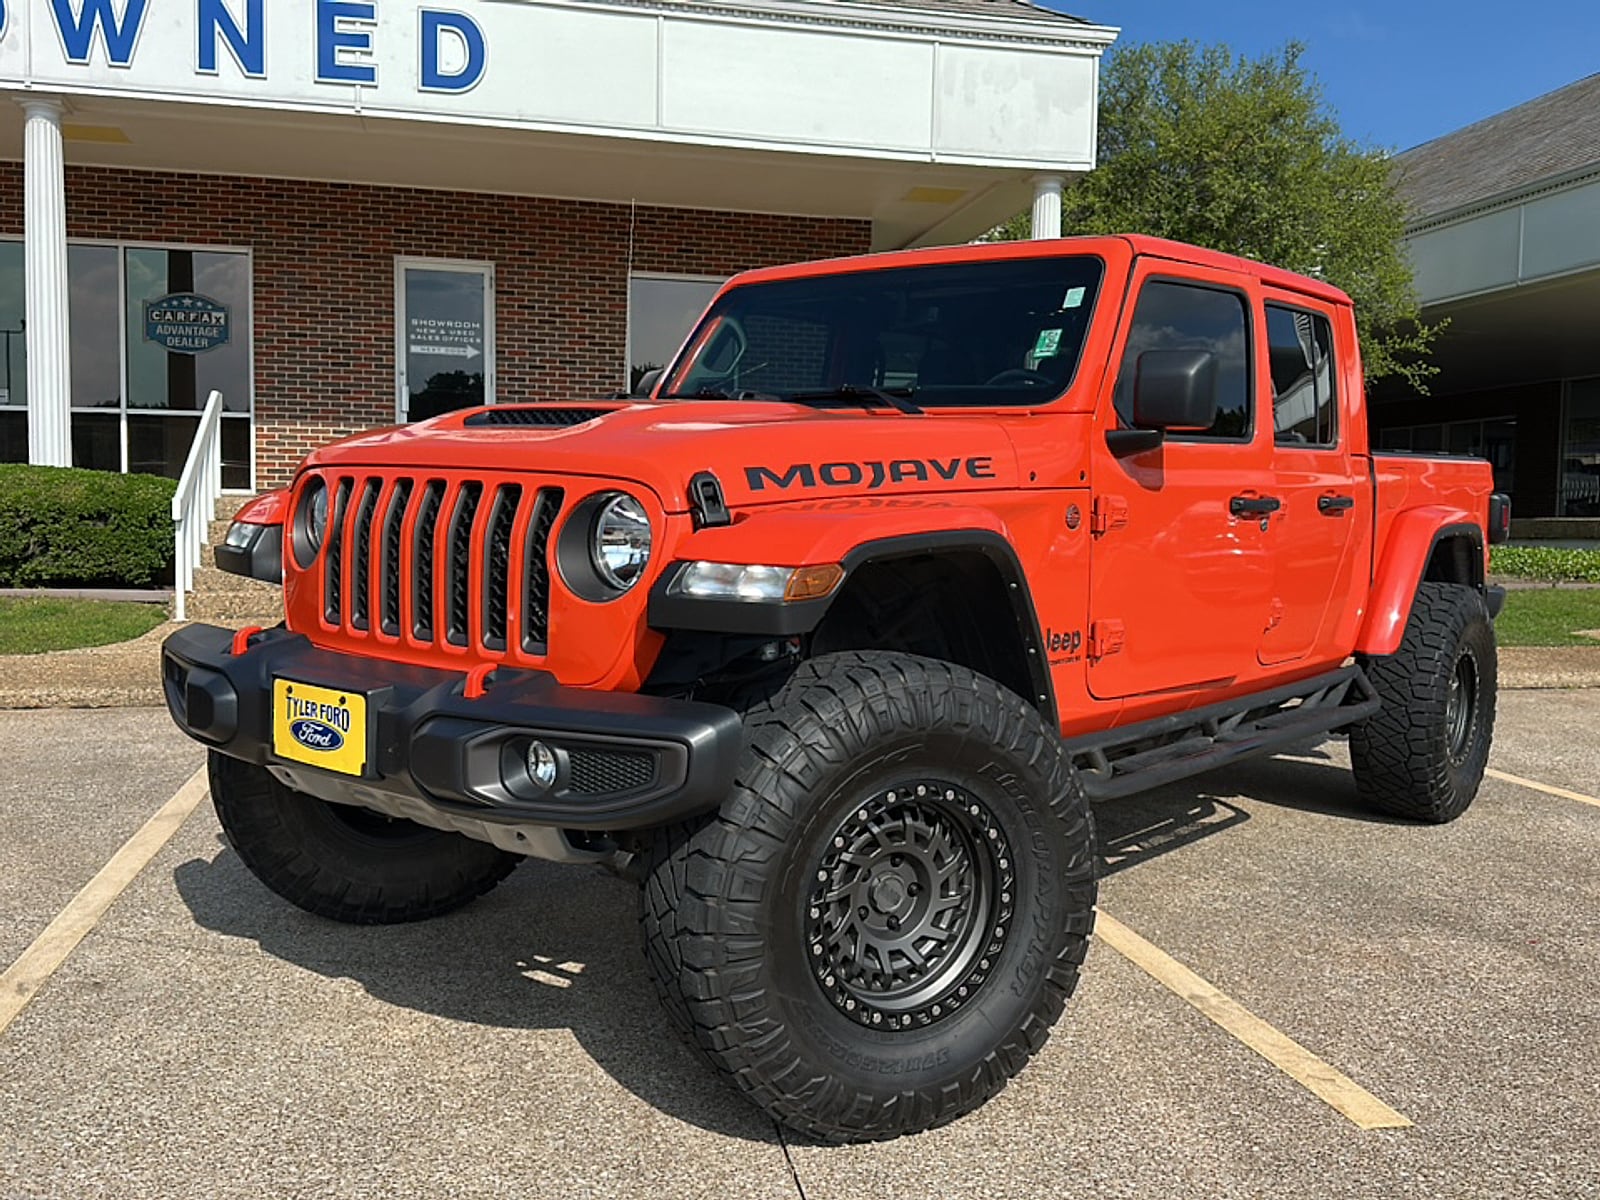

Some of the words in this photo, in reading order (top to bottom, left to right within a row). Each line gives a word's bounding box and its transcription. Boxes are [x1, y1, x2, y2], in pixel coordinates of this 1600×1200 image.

[0, 0, 486, 95] WNED
[151, 311, 224, 325] CARFAX
[411, 319, 480, 329] SHOWROOM
[156, 325, 220, 337] ADVANTAGE
[410, 333, 440, 341] SALES
[166, 337, 208, 348] DEALER
[744, 457, 996, 490] MOJAVE
[286, 696, 318, 720] TYLER
[320, 704, 350, 733] FORD
[299, 721, 332, 747] Ford
